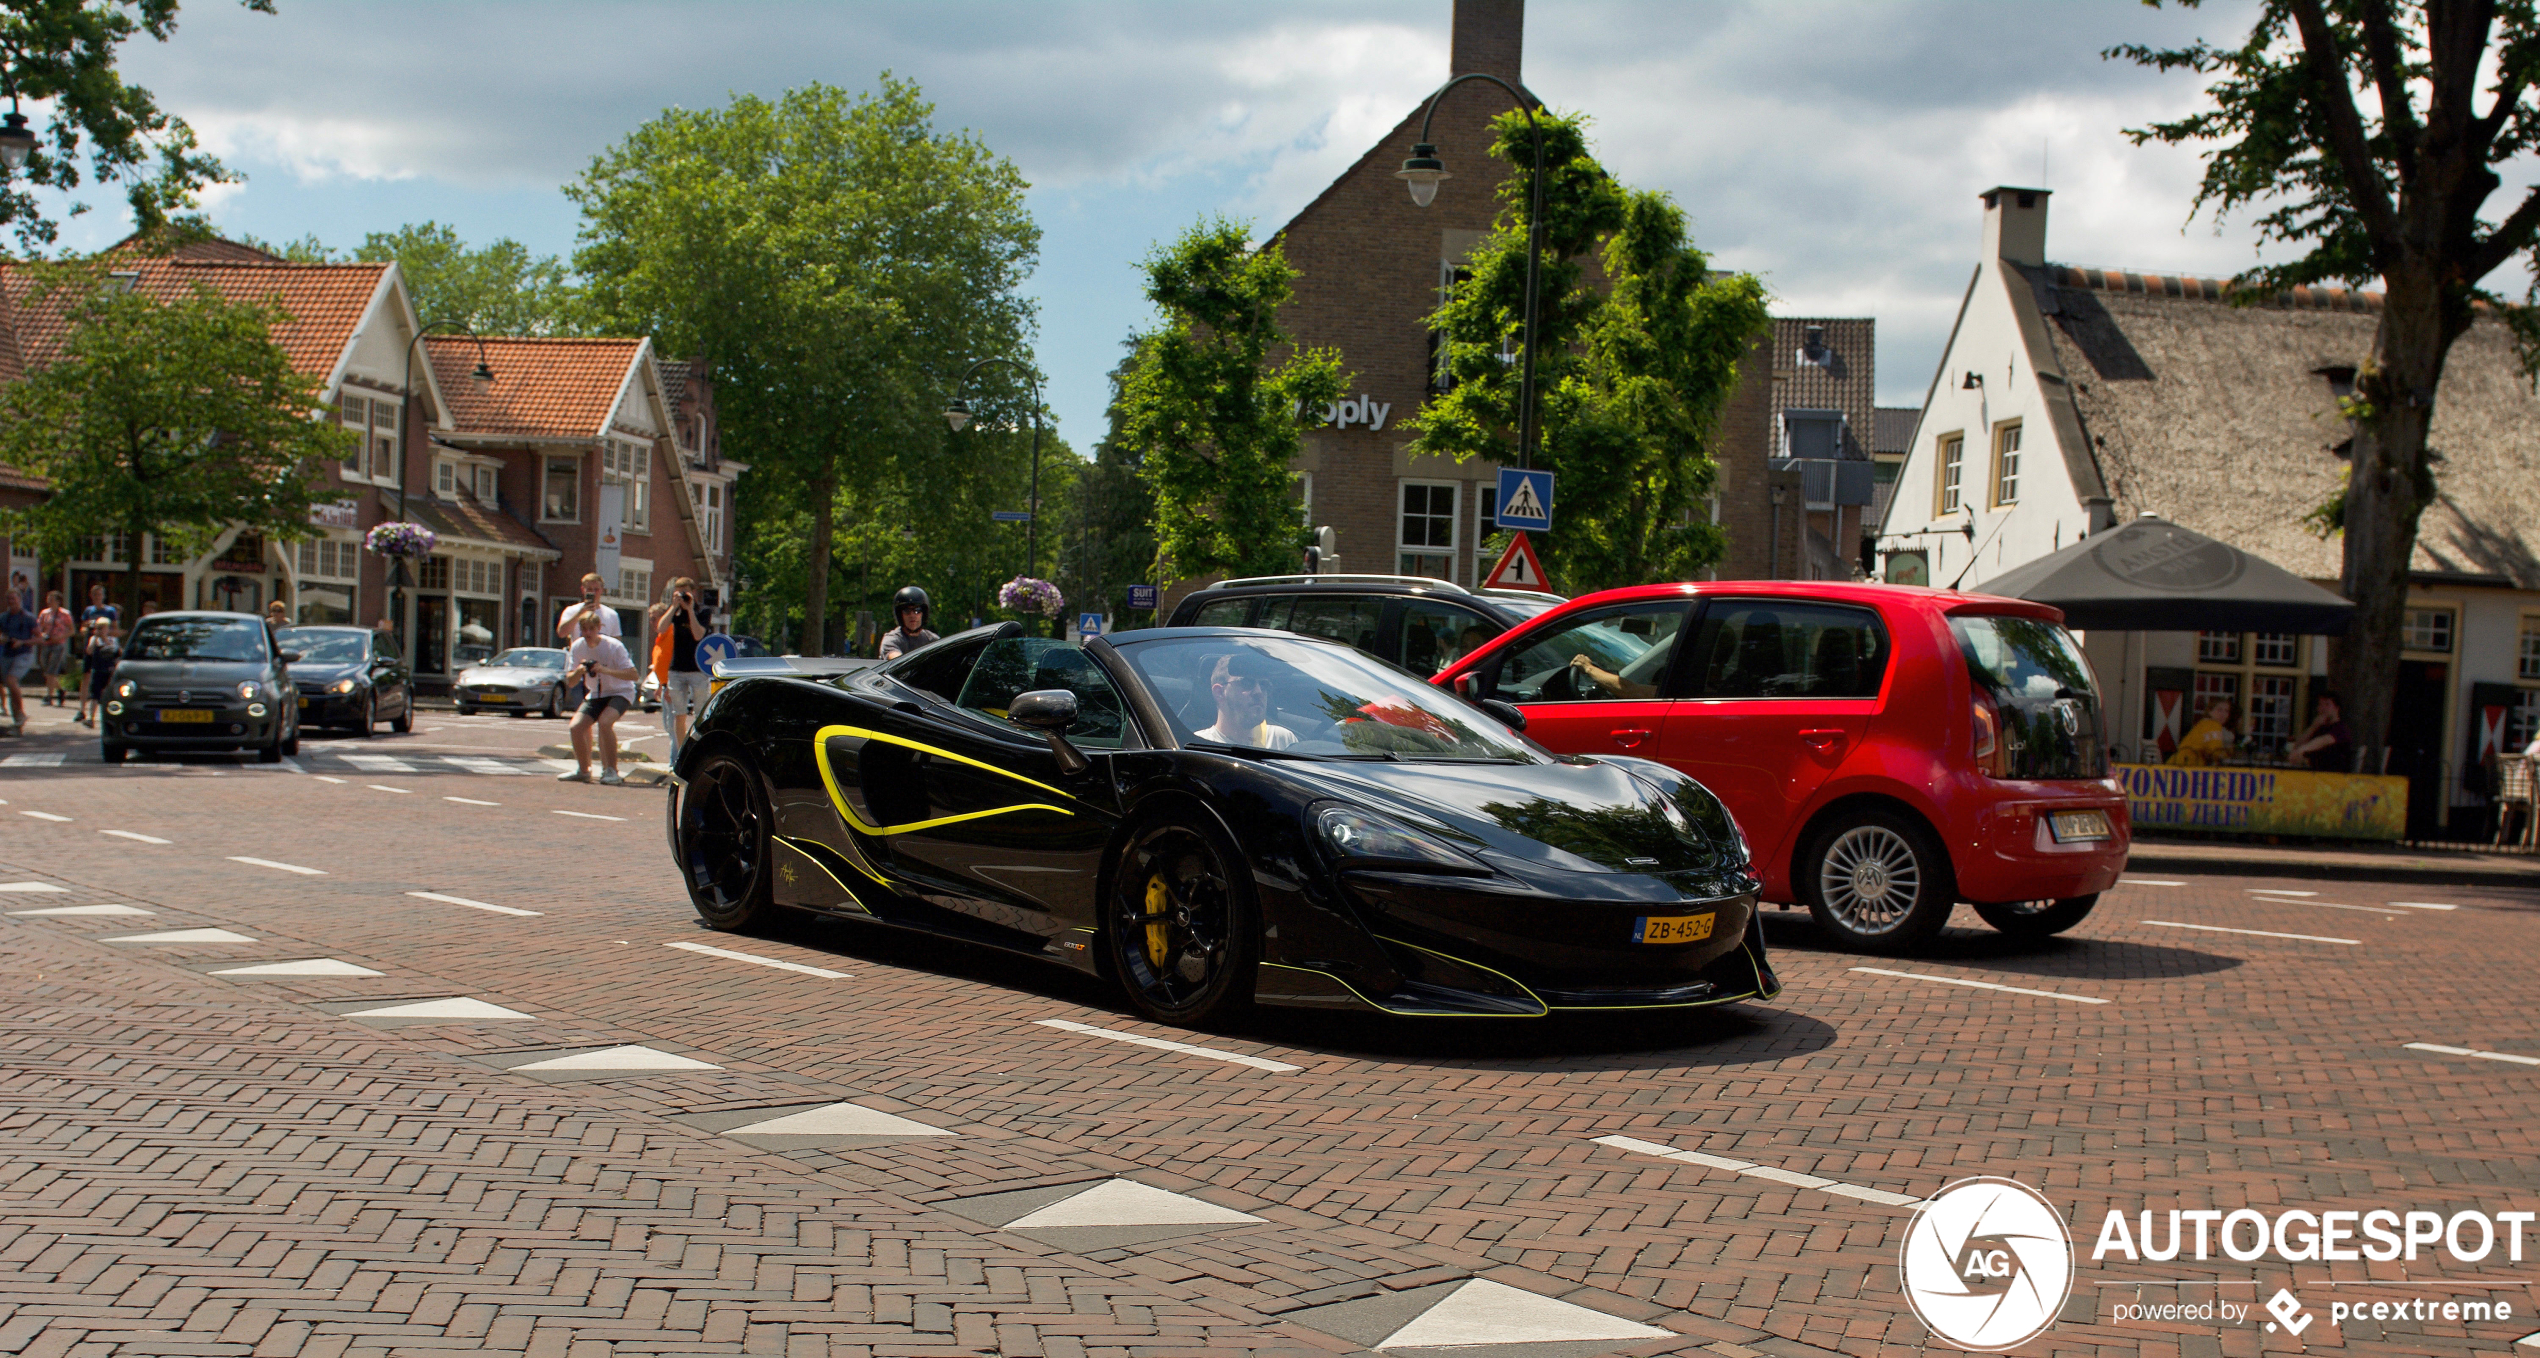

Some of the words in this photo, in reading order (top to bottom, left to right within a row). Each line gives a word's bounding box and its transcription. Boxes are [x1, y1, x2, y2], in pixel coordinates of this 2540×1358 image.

[1294, 394, 1391, 431] pply
[1133, 588, 1154, 598] SUIT
[2114, 766, 2276, 804] ZONDHEID!!
[2131, 801, 2185, 823] ULLIE
[1633, 932, 1643, 940] NL
[1648, 918, 1712, 939] ZB-452-G
